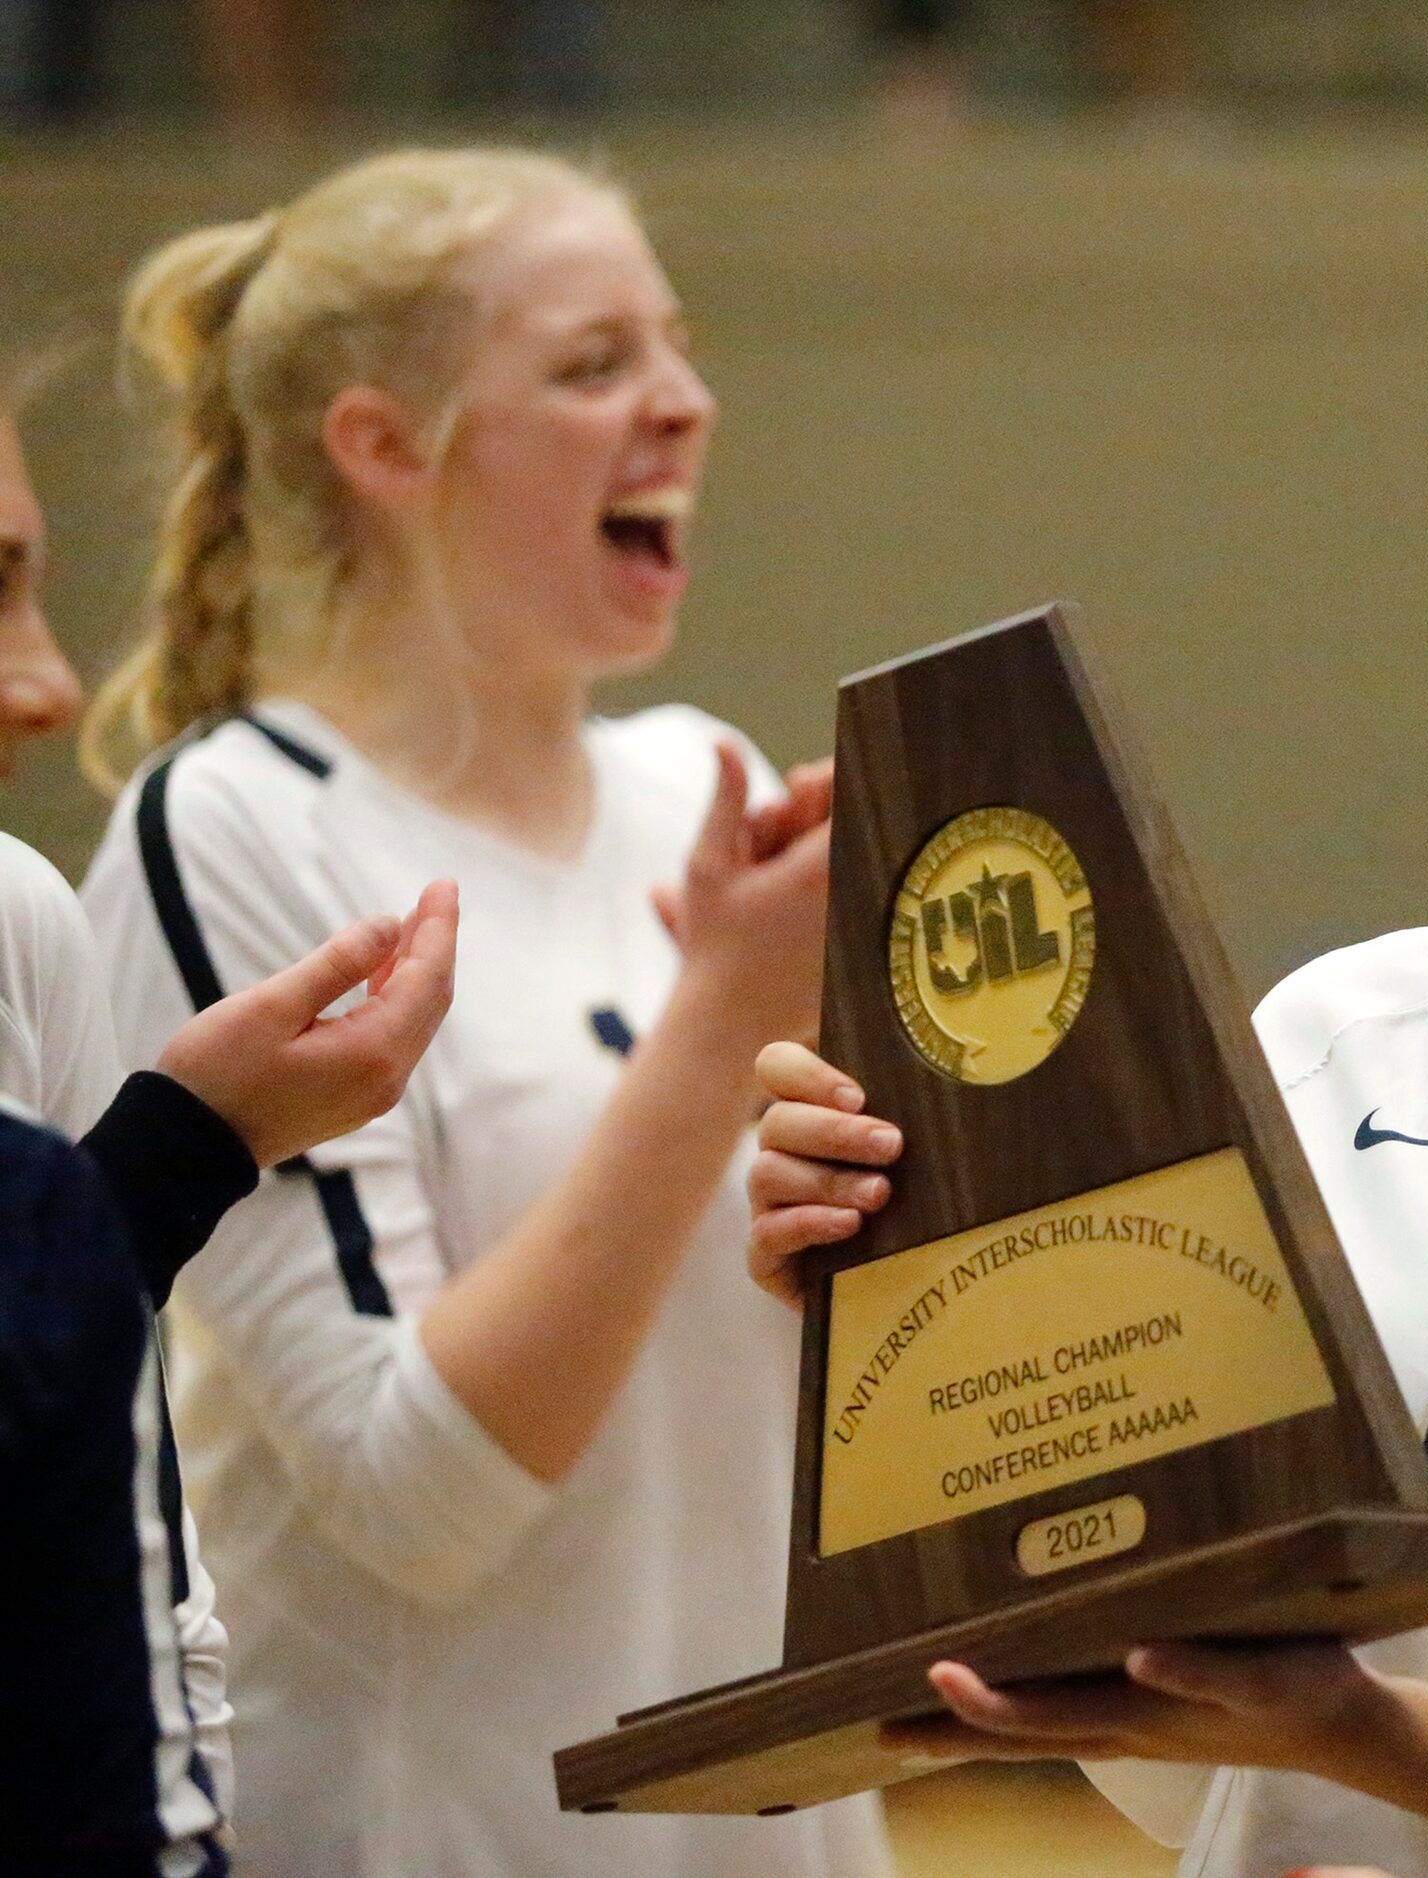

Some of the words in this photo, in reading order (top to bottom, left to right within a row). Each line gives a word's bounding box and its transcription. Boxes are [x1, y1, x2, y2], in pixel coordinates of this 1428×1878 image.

[920, 866, 1061, 996] UIL
[832, 1279, 948, 1445] UNIVERSITY
[950, 1214, 1175, 1295] INTERSCHOLASTIC
[1180, 1228, 1282, 1314] LEAGUE
[929, 1356, 1049, 1416] REGIONAL
[1053, 1310, 1182, 1375] CHAMPION
[942, 1422, 1103, 1499] CONFERENCE
[1109, 1396, 1200, 1447] AAAAAA
[988, 1373, 1136, 1439] VOLLEYBALL
[1046, 1508, 1117, 1560] 2021
